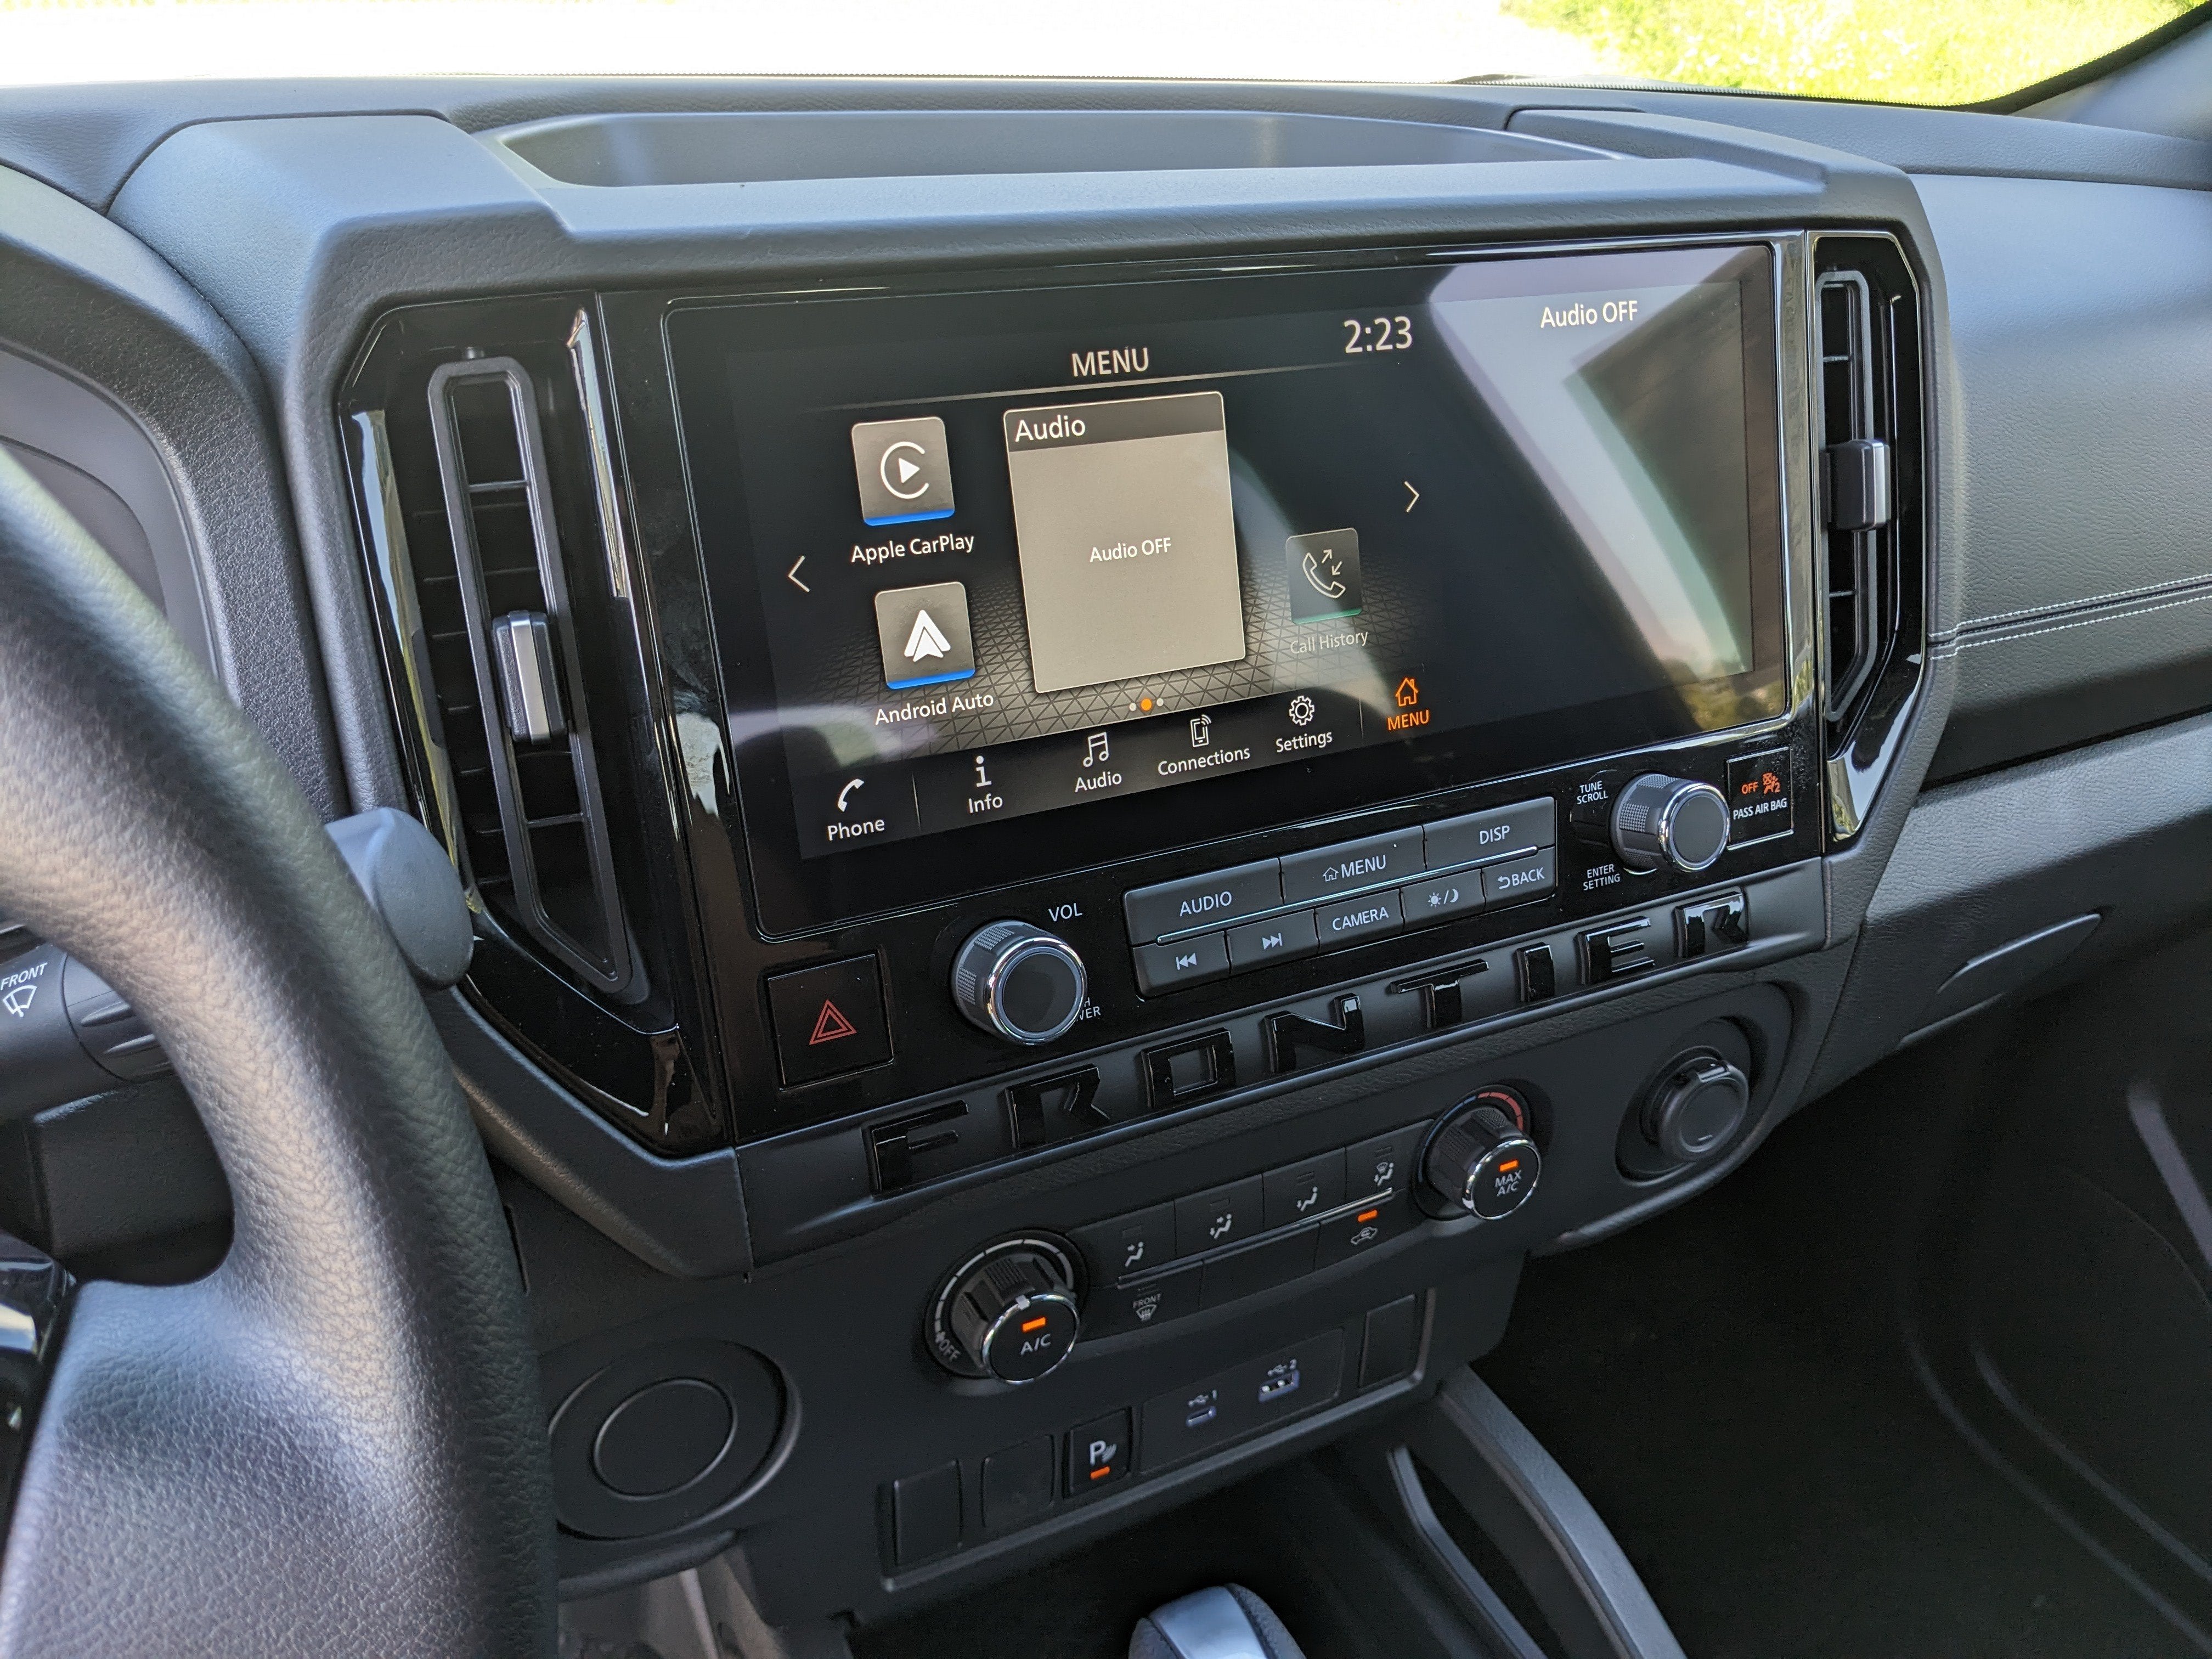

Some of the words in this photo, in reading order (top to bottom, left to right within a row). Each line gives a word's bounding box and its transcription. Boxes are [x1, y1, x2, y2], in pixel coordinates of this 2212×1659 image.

[1541, 303, 1598, 328] Audio
[1602, 300, 1638, 323] OFF
[1344, 316, 1413, 353] 2:23
[1071, 347, 1149, 377] MENU
[1014, 414, 1086, 442] Audio
[851, 540, 906, 565] Apple
[909, 533, 974, 555] CarPlay
[1089, 543, 1137, 563] Audio
[1142, 537, 1171, 555] OFF
[1290, 636, 1315, 654] Call
[1319, 631, 1368, 650] History
[874, 698, 947, 725] Android
[951, 693, 994, 713] Auto
[1387, 709, 1429, 731] MENU
[1276, 731, 1333, 753] Settings
[1158, 746, 1250, 776] Connections
[1075, 771, 1122, 793] Audio
[1579, 781, 1602, 794] TUNE
[1741, 782, 1758, 794] OFF
[968, 793, 1003, 814] Info
[1577, 790, 1609, 805] SCROLL
[1733, 806, 1754, 820] PASS
[1754, 802, 1770, 815] AIR
[1770, 798, 1787, 811] BAG
[827, 819, 885, 841] Phone
[1480, 825, 1510, 845] DISP
[1341, 854, 1386, 878] MENU
[1511, 867, 1545, 886] BACK
[1587, 864, 1614, 878] ENTER
[1583, 873, 1621, 890] SETTING
[1048, 902, 1083, 922] VOL
[1180, 891, 1232, 917] AUDIO
[1332, 906, 1389, 930] CAMERA
[0, 962, 48, 991] FRONT
[866, 890, 1748, 1192] FRONTIER
[1495, 1170, 1521, 1188] MAX
[1497, 1181, 1519, 1197] A/C
[1020, 1333, 1051, 1355] A/C
